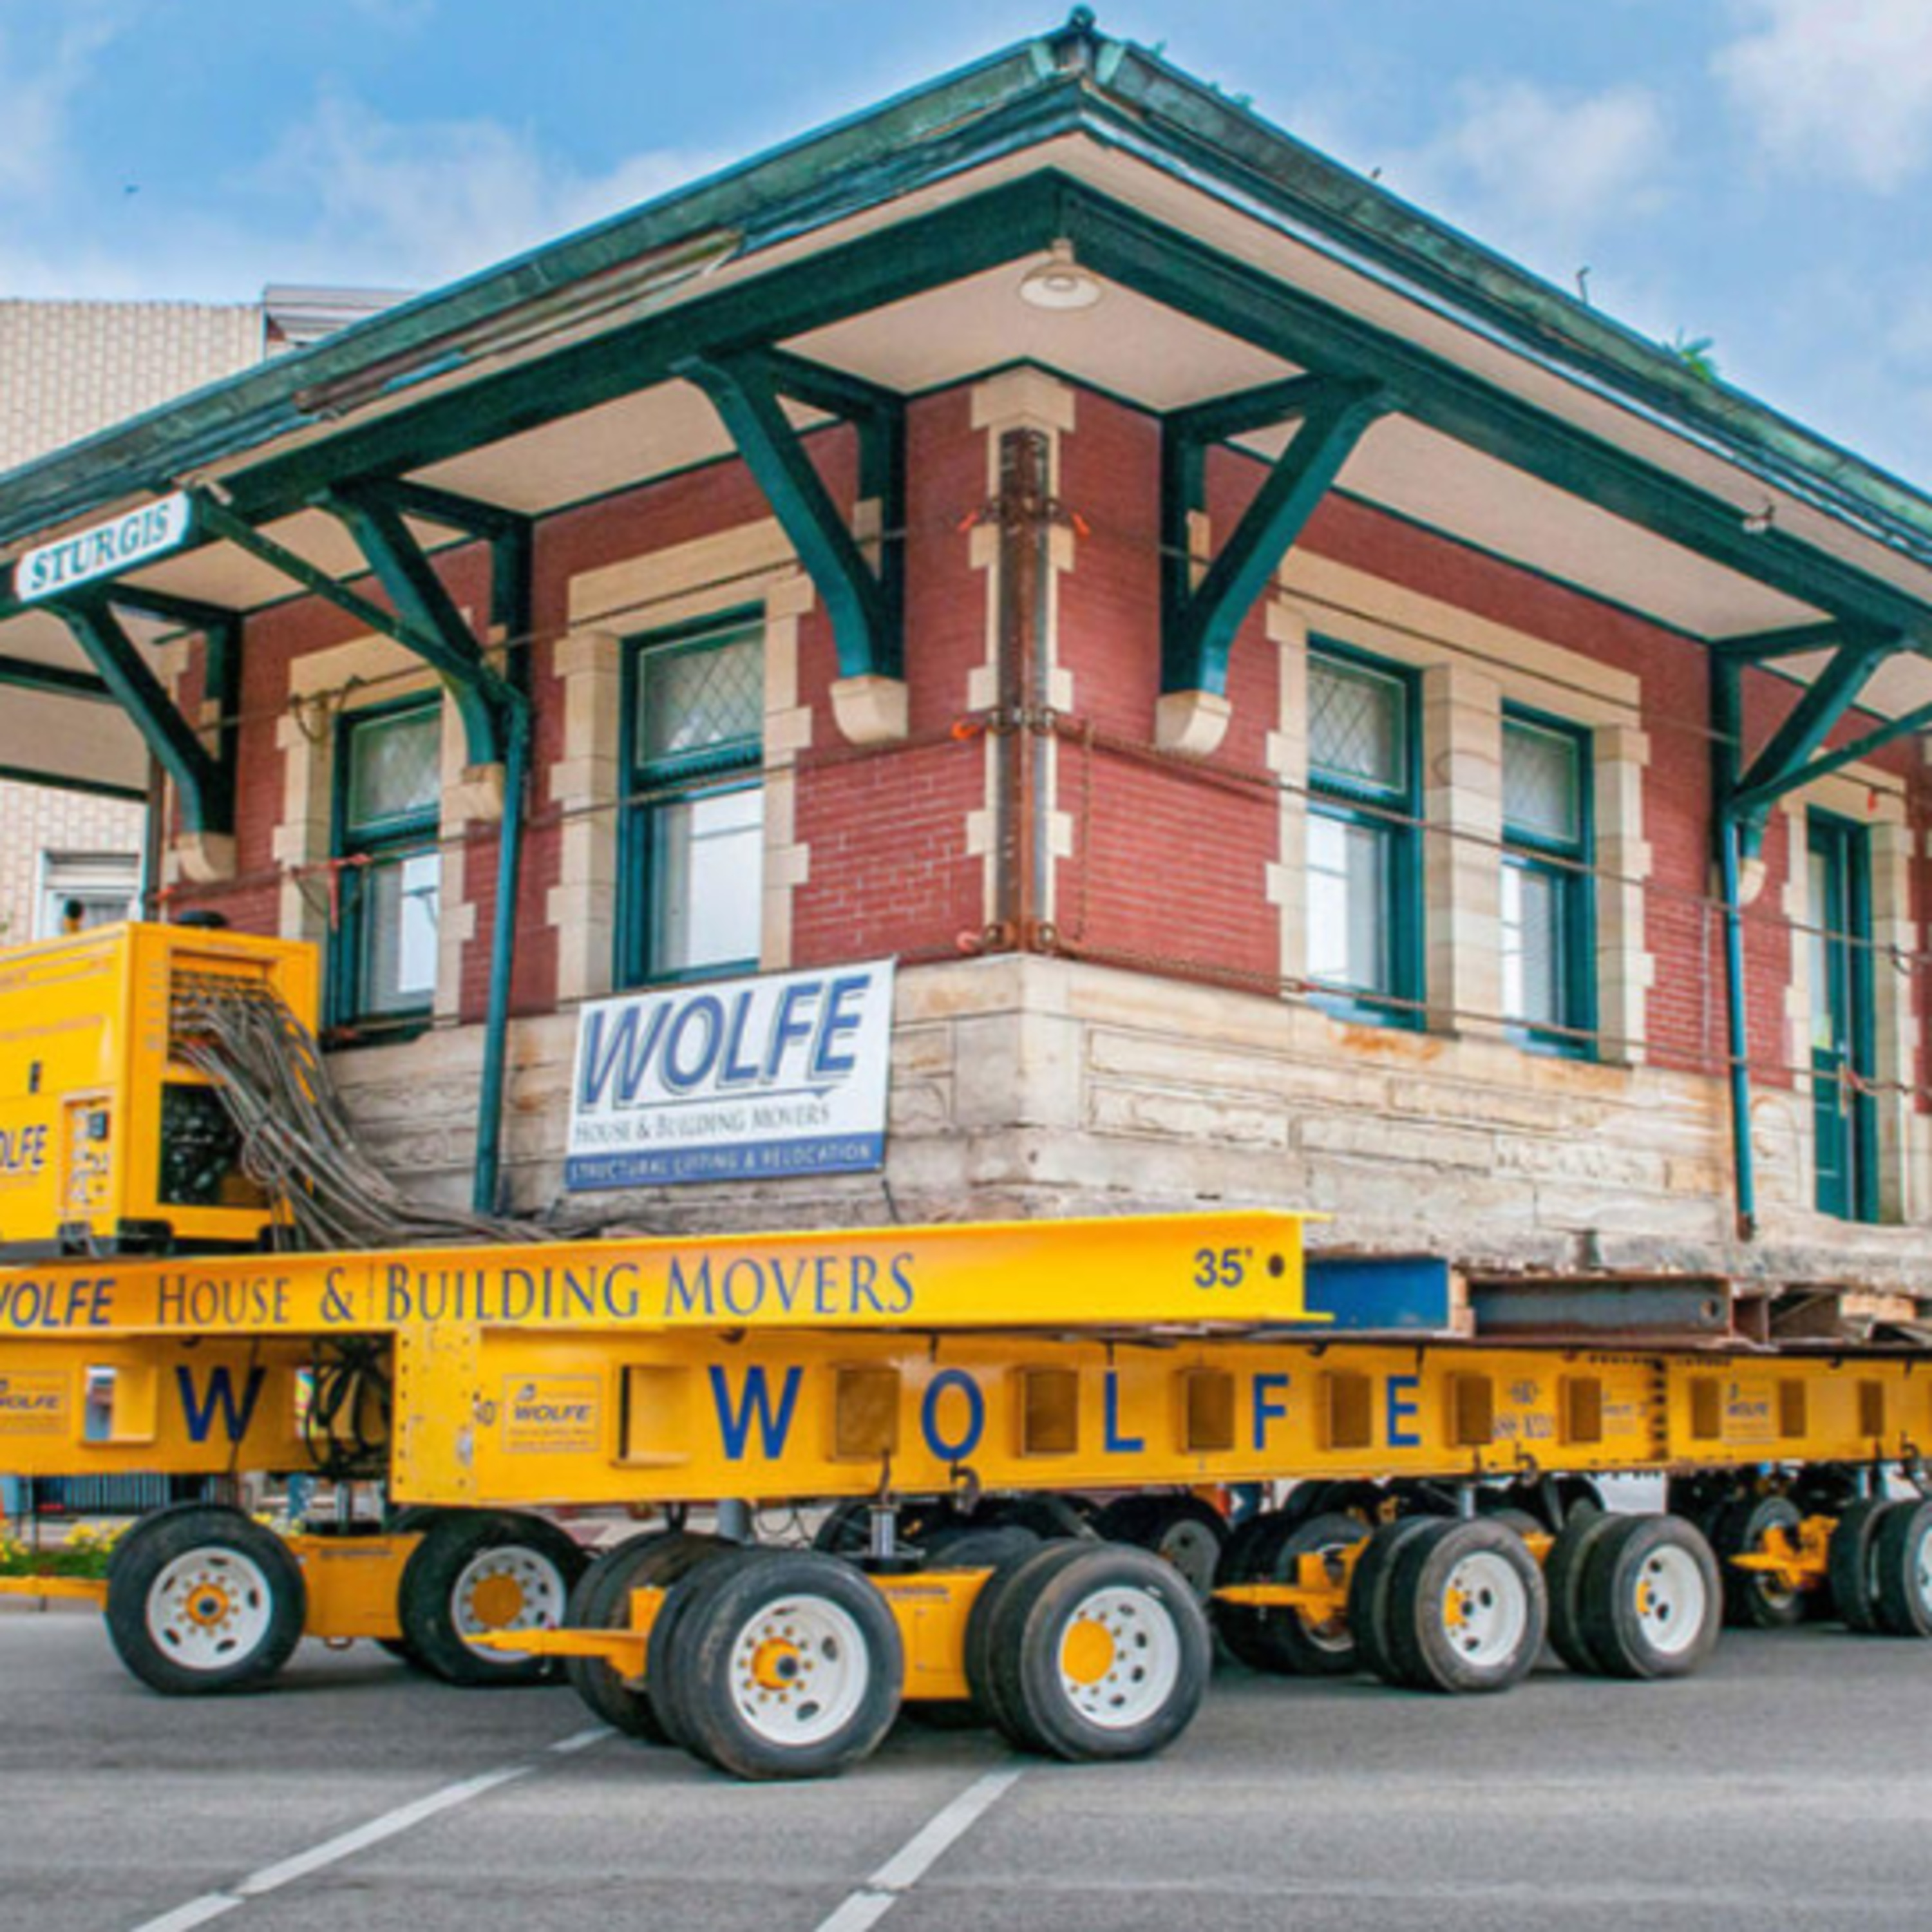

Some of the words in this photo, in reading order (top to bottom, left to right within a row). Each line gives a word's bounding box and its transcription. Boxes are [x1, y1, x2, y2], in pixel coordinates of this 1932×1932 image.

[30, 502, 169, 590] STURGIS
[576, 974, 871, 1114] WOLFE
[574, 1121, 630, 1145] HOUSE
[637, 1117, 650, 1139] &
[656, 1112, 746, 1139] BUILDING
[752, 1104, 831, 1130] MOVERS
[156, 1274, 291, 1325] HOUSE
[320, 1266, 355, 1323] &
[386, 1262, 640, 1321] BUILDING
[663, 1251, 916, 1318] MOVERS
[177, 1365, 267, 1443] W
